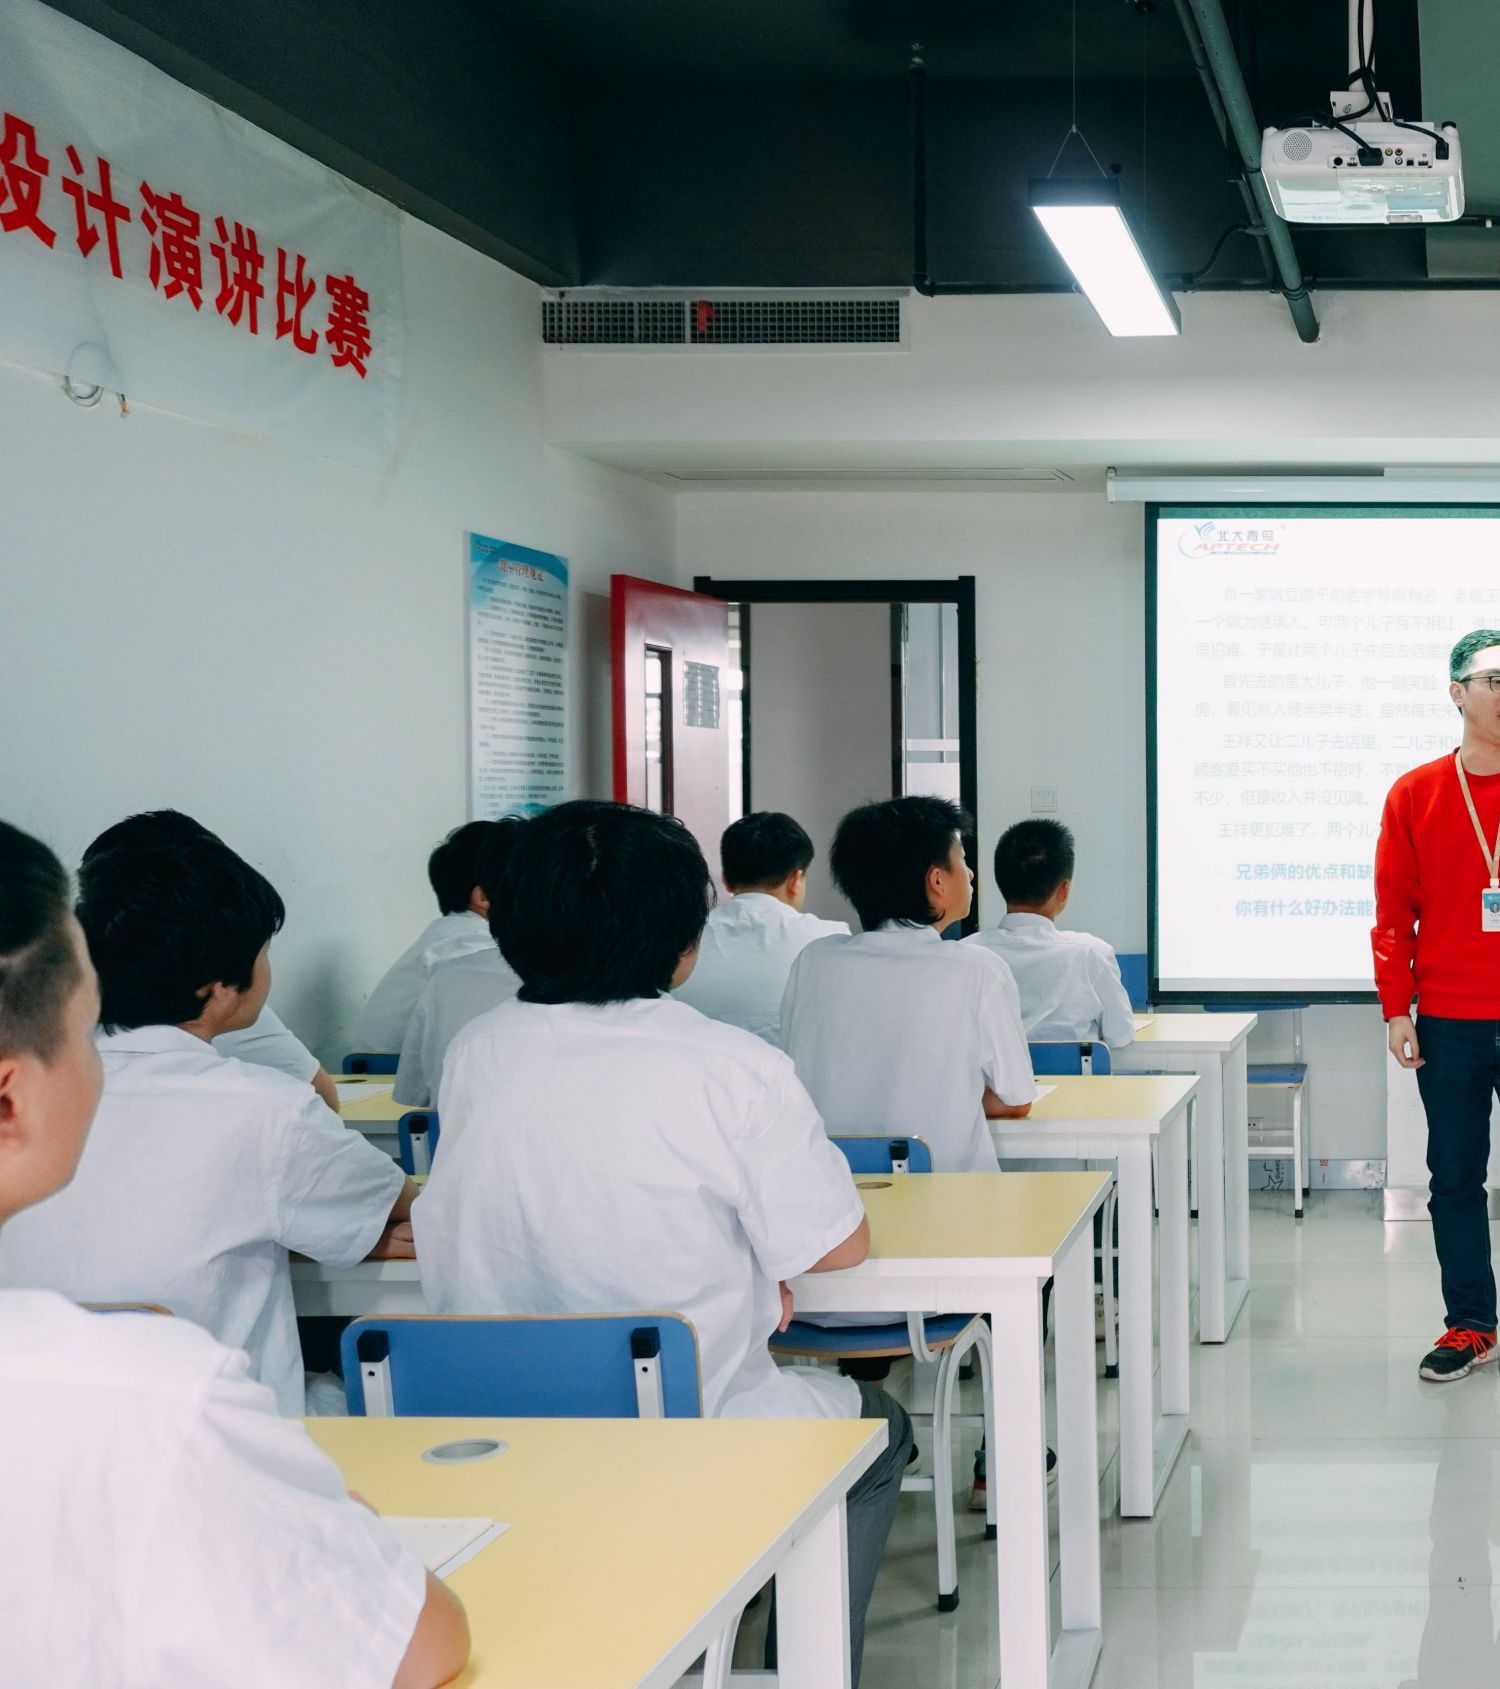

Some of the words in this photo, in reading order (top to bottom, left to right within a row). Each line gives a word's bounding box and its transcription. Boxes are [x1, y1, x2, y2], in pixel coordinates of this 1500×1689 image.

[0, 112, 373, 380] 设计演讲比赛
[1216, 529, 1275, 542] 北大青鸟
[1192, 543, 1281, 551] APTECH
[1235, 899, 1374, 917] 你有什么好办法能
